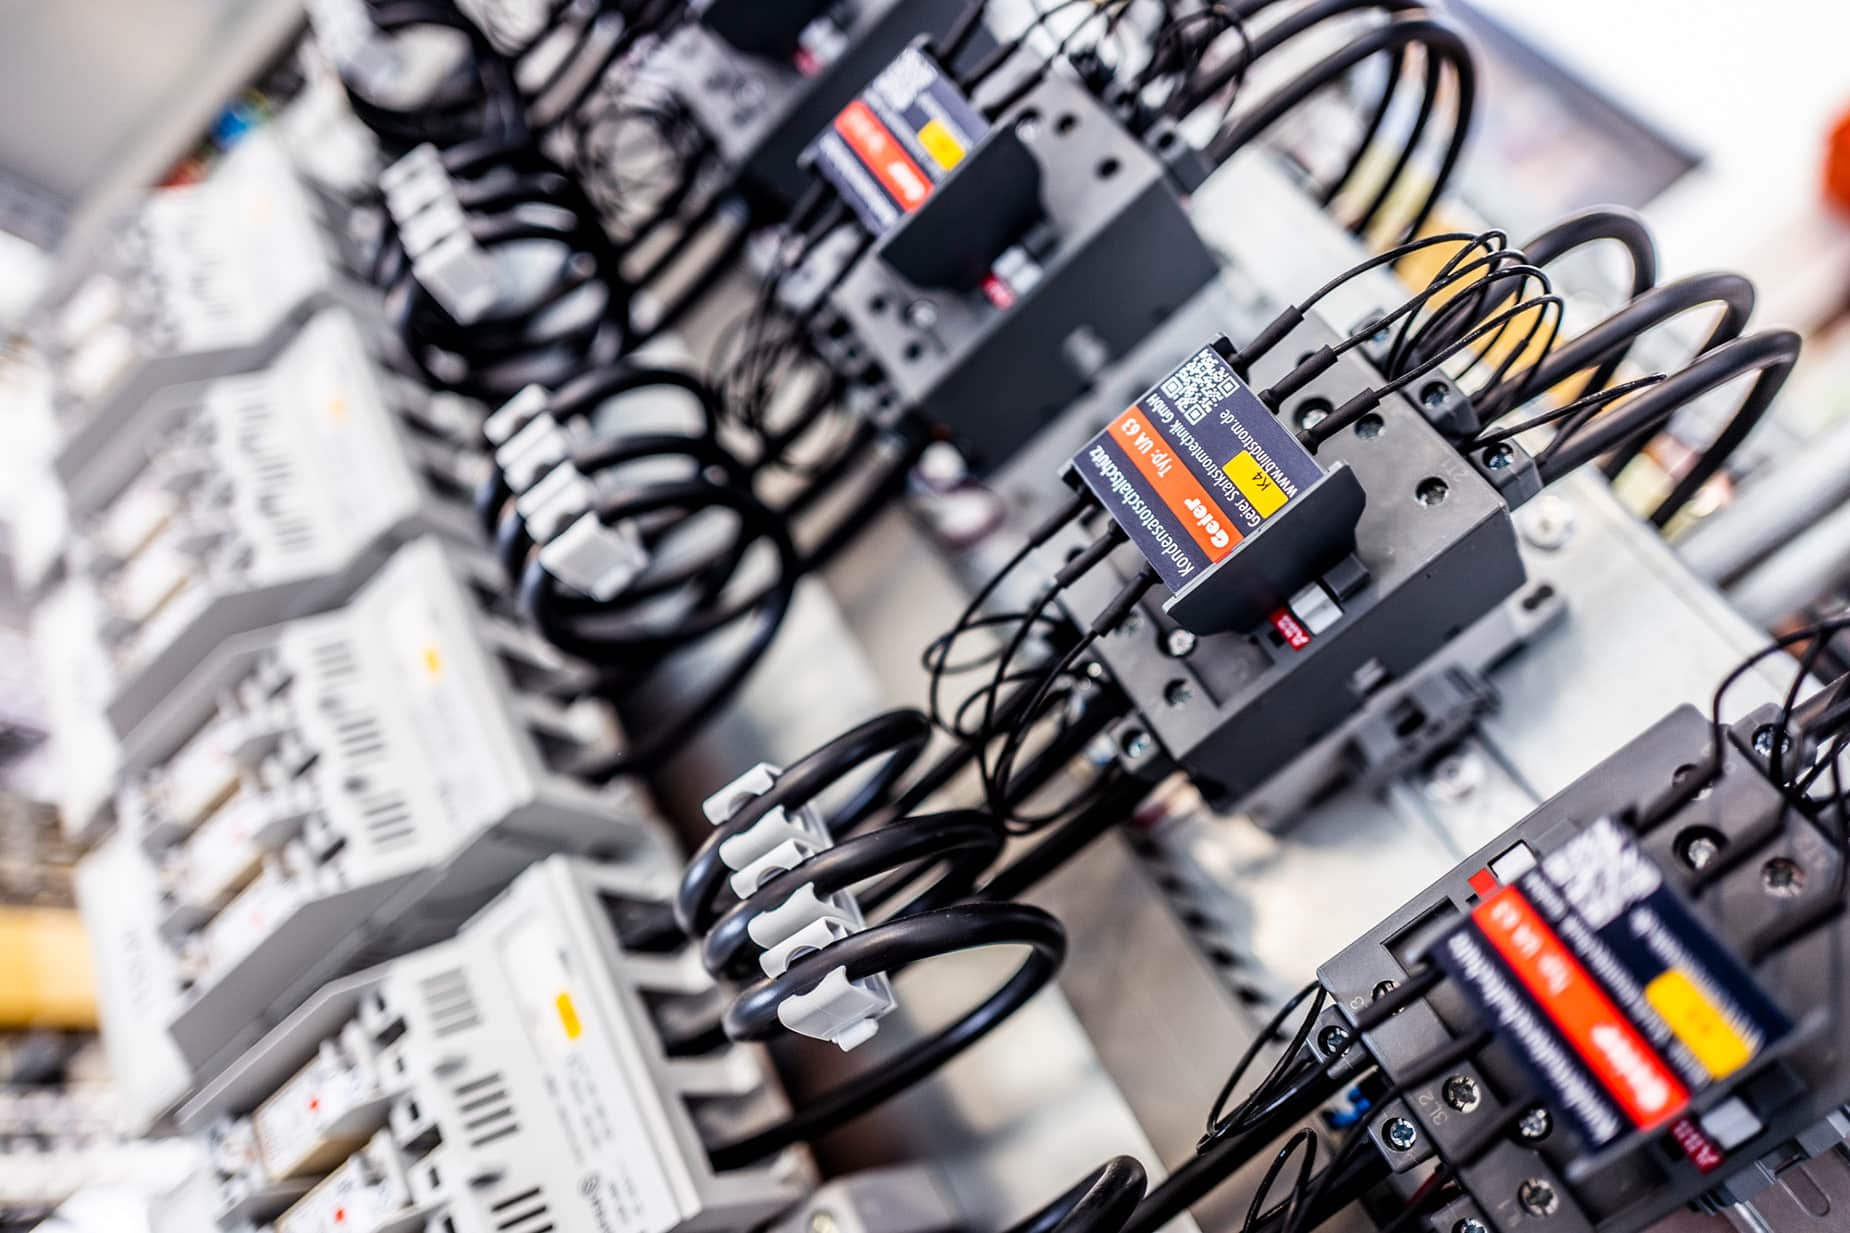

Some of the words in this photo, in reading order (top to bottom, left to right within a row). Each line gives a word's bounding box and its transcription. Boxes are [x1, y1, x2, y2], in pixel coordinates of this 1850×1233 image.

[1146, 393, 1175, 422] GmbH
[1120, 416, 1138, 433] 63
[1133, 431, 1154, 455] UA
[1220, 408, 1298, 498] www.blindstrom.de
[1151, 448, 1174, 478] Typ:
[1172, 420, 1241, 502] Starkstromtechnik
[1252, 471, 1270, 491] K4
[1089, 445, 1195, 577] Kondensatorschaltschütz
[1184, 498, 1229, 548] Geier
[1237, 498, 1261, 527] Geier
[1418, 1092, 1449, 1126] 3L2
